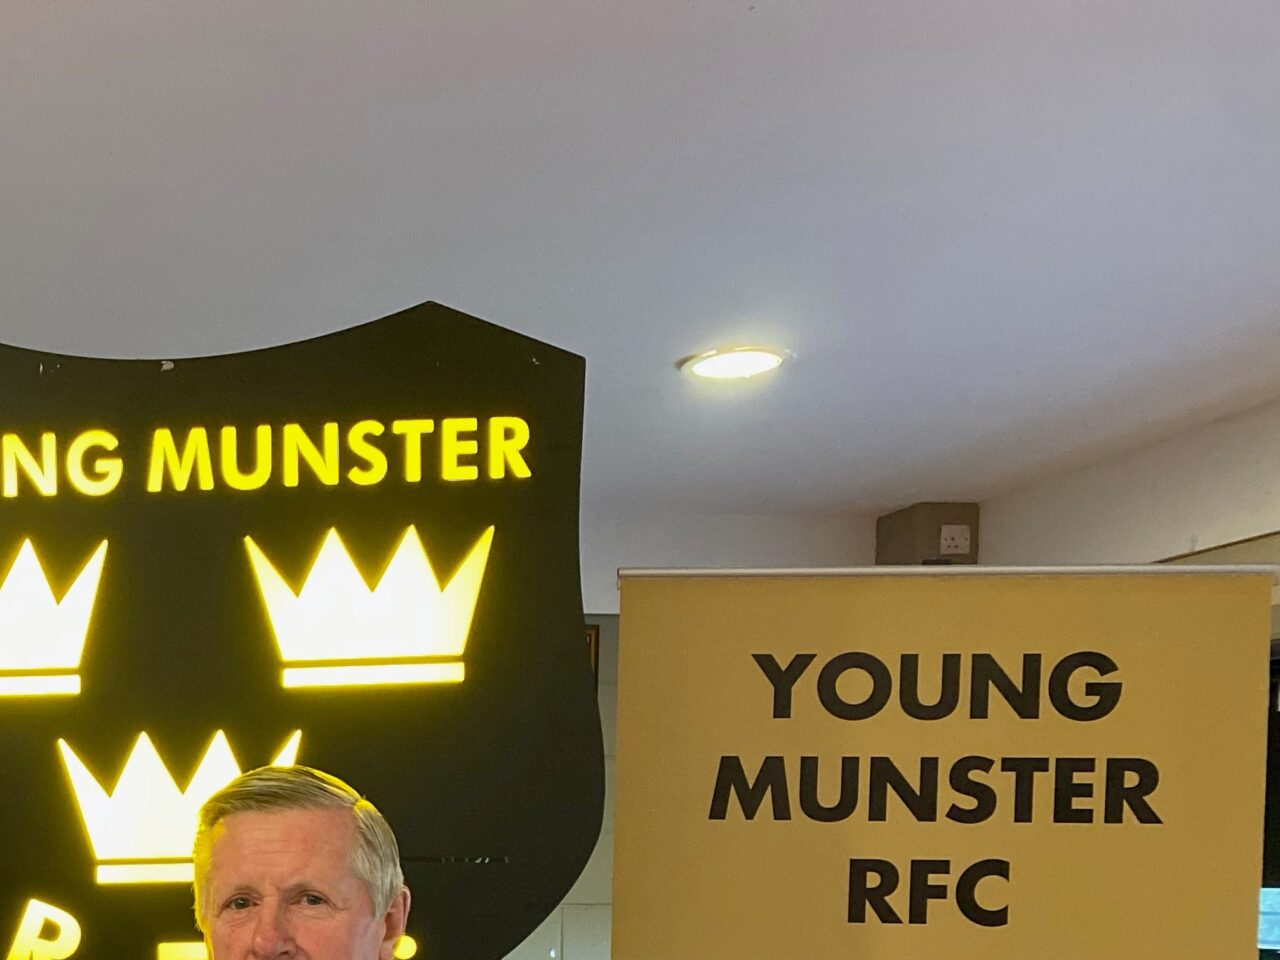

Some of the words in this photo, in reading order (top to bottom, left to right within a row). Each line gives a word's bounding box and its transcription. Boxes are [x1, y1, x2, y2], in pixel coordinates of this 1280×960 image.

[146, 415, 533, 493] MUNSTER
[751, 651, 1123, 722] YOUNG
[708, 755, 1164, 825] MUNSTER
[847, 858, 1010, 928] RFC
